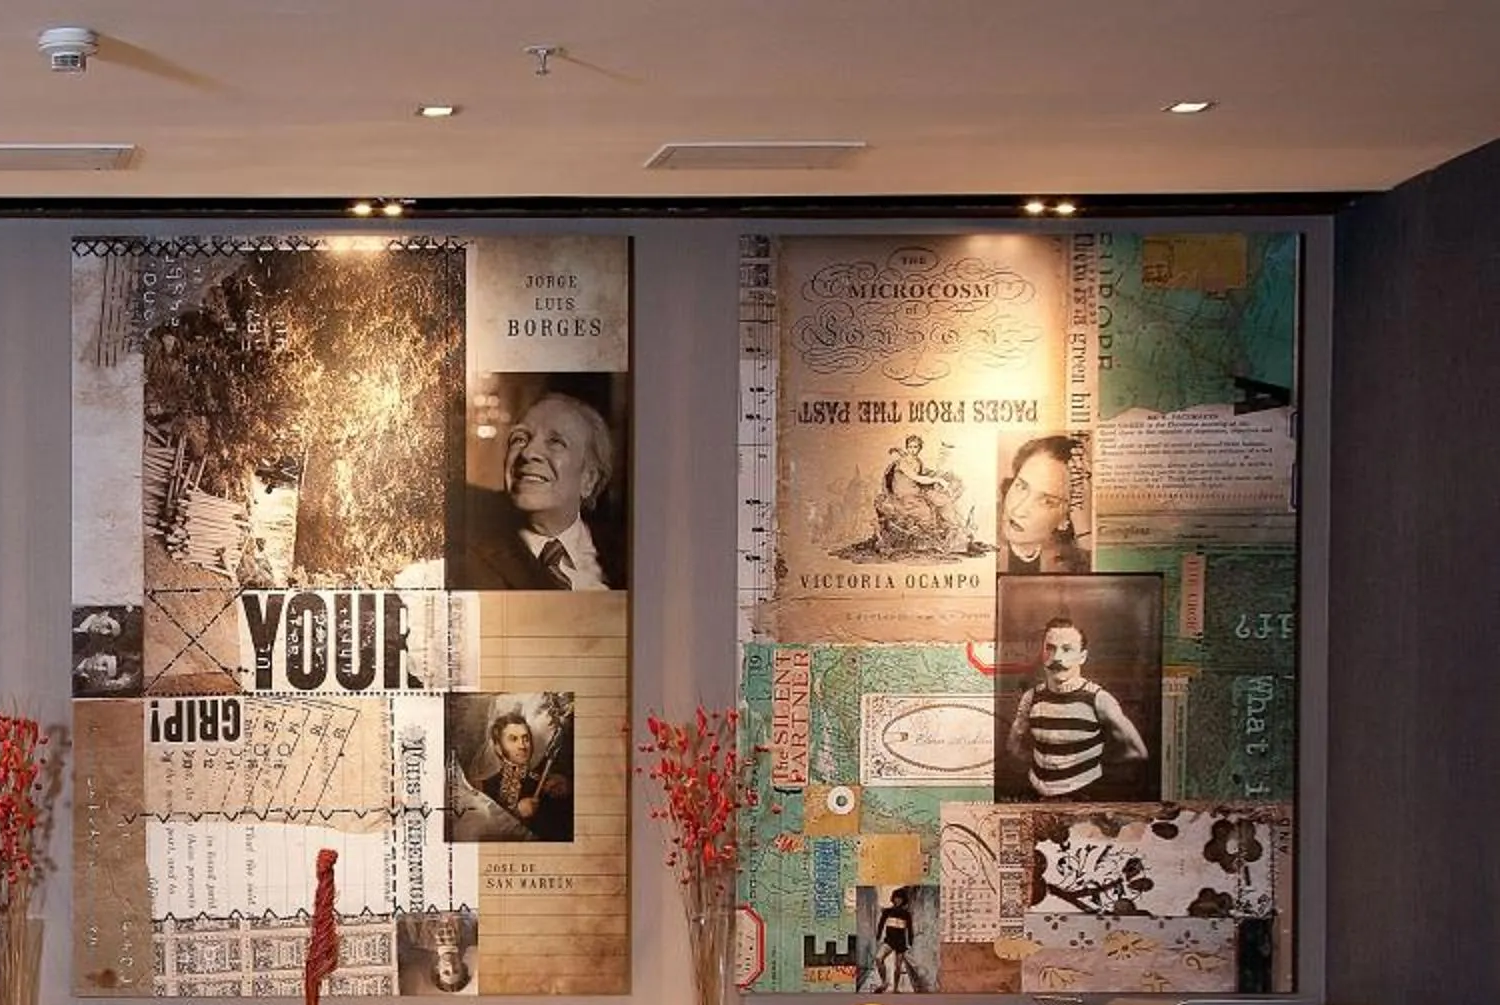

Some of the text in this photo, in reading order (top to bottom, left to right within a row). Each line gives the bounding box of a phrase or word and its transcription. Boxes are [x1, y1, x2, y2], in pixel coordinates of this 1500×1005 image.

[525, 275, 578, 289] JORGE
[847, 283, 991, 299] MICROCOSM
[535, 297, 575, 311] LUIS
[507, 318, 602, 337] BORGES
[1069, 333, 1087, 383] green
[797, 400, 1039, 424] PAGES FROM THE PAST
[1071, 392, 1091, 422] hill
[801, 573, 980, 589] VICTORIA OCAMPO
[241, 592, 425, 691] YOUR
[151, 699, 241, 742] GRIP!
[771, 651, 791, 781] The SILENT
[791, 652, 807, 783] PARTNER
[485, 877, 513, 889] SAN
